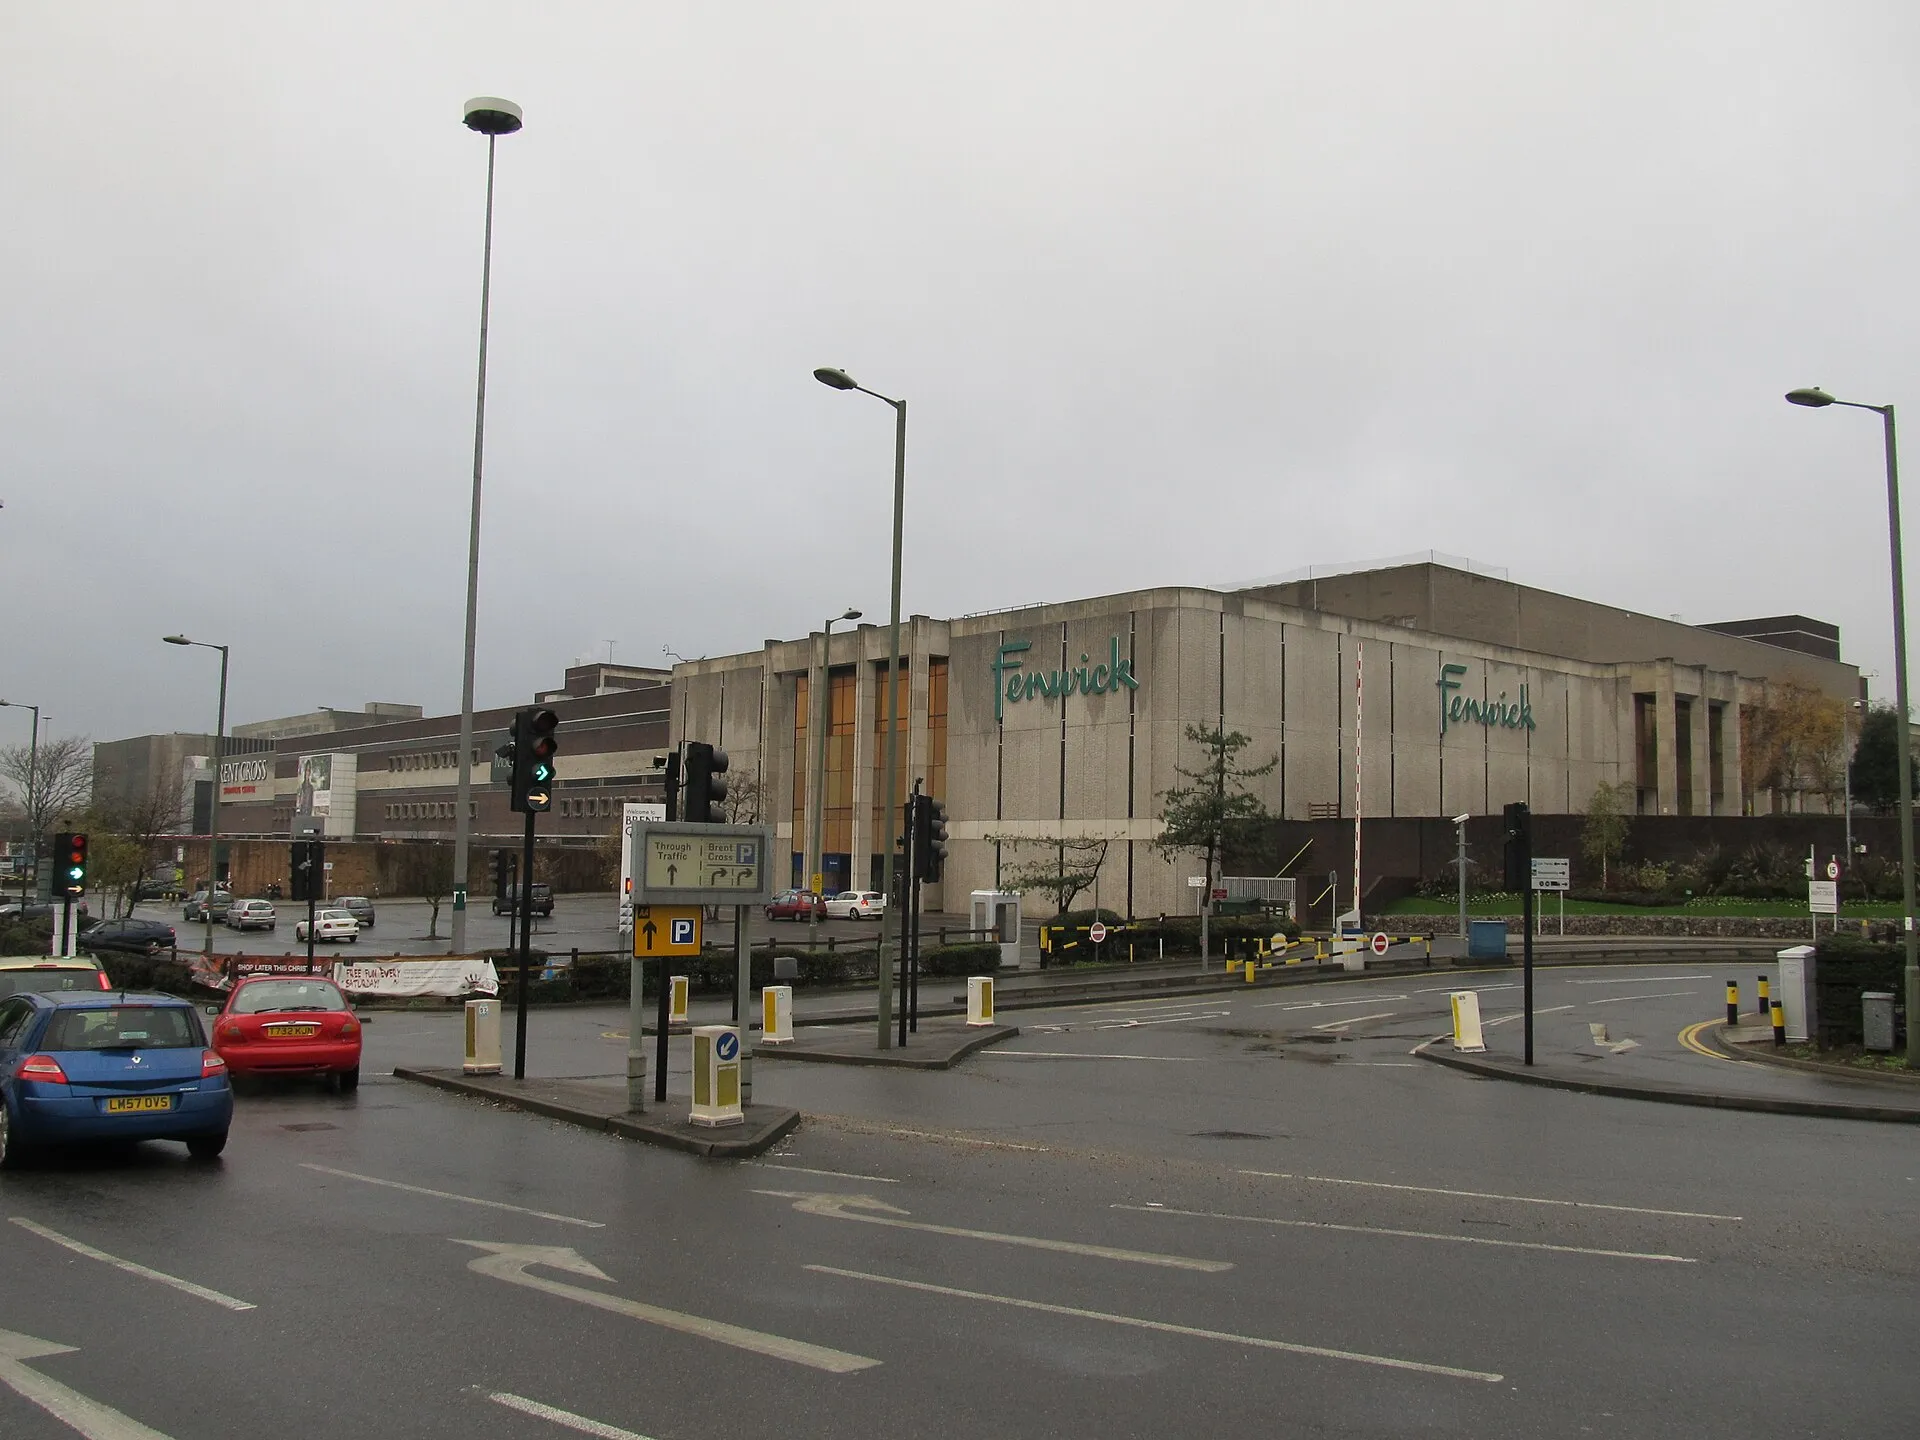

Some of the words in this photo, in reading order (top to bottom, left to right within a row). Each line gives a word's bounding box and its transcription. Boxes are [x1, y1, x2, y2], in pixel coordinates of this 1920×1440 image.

[990, 636, 1139, 720] Fenwick
[1435, 663, 1536, 733] Fenwick
[240, 759, 267, 781] CROSS
[654, 841, 692, 852] Through
[708, 843, 733, 852] Brent
[657, 851, 688, 861] Traffic
[707, 852, 733, 861] Cross
[675, 920, 691, 942] P
[273, 964, 287, 972] THIS
[346, 968, 361, 978] FREE
[365, 968, 377, 978] FUN
[269, 1027, 293, 1035] T732
[294, 1026, 313, 1035] KJN
[109, 1098, 141, 1110] LM57
[144, 1096, 168, 1108] OVS
